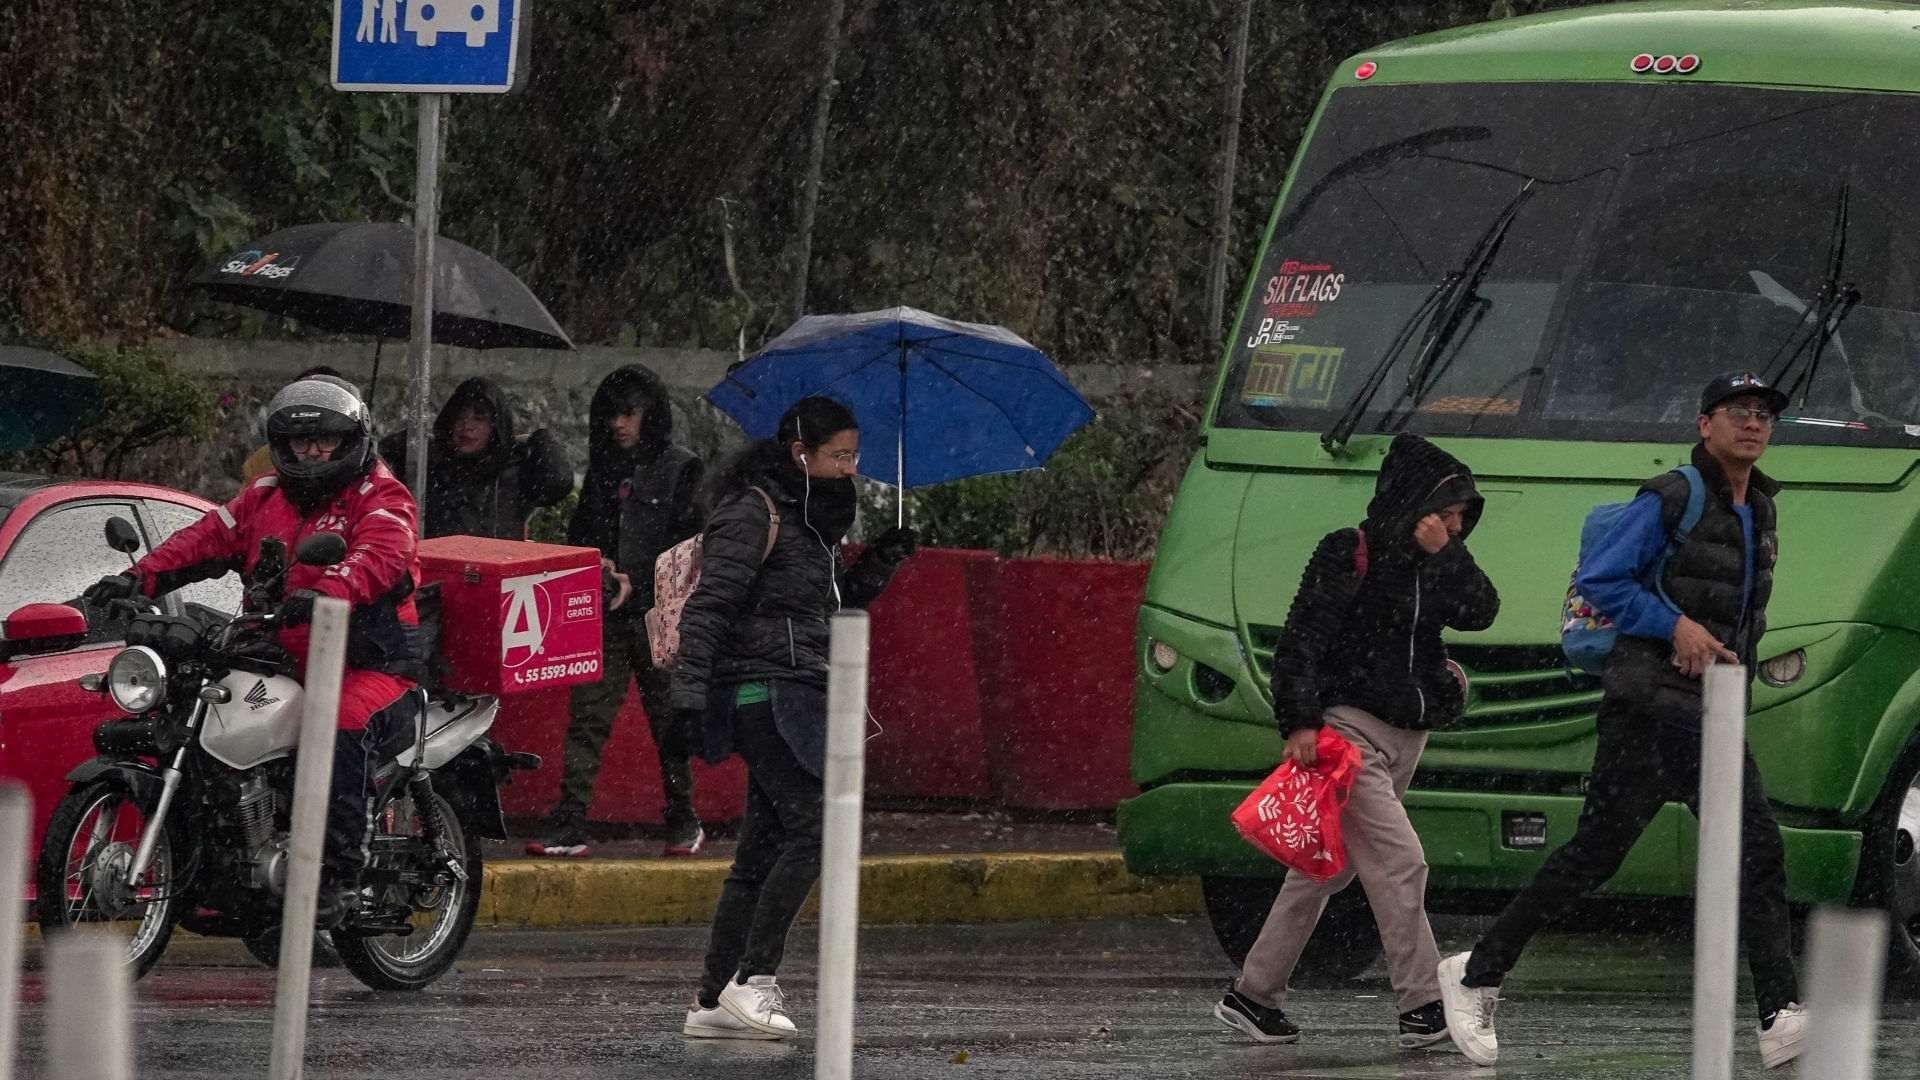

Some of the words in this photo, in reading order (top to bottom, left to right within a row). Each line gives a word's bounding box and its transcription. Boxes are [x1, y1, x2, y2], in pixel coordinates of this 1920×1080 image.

[1263, 275, 1292, 305] SIX
[1289, 273, 1345, 303] FLAGS
[568, 593, 592, 607] ENVÍO
[566, 607, 593, 619] GRATIS
[525, 667, 539, 683] 55
[540, 663, 566, 681] 5593
[567, 659, 598, 676] 4000
